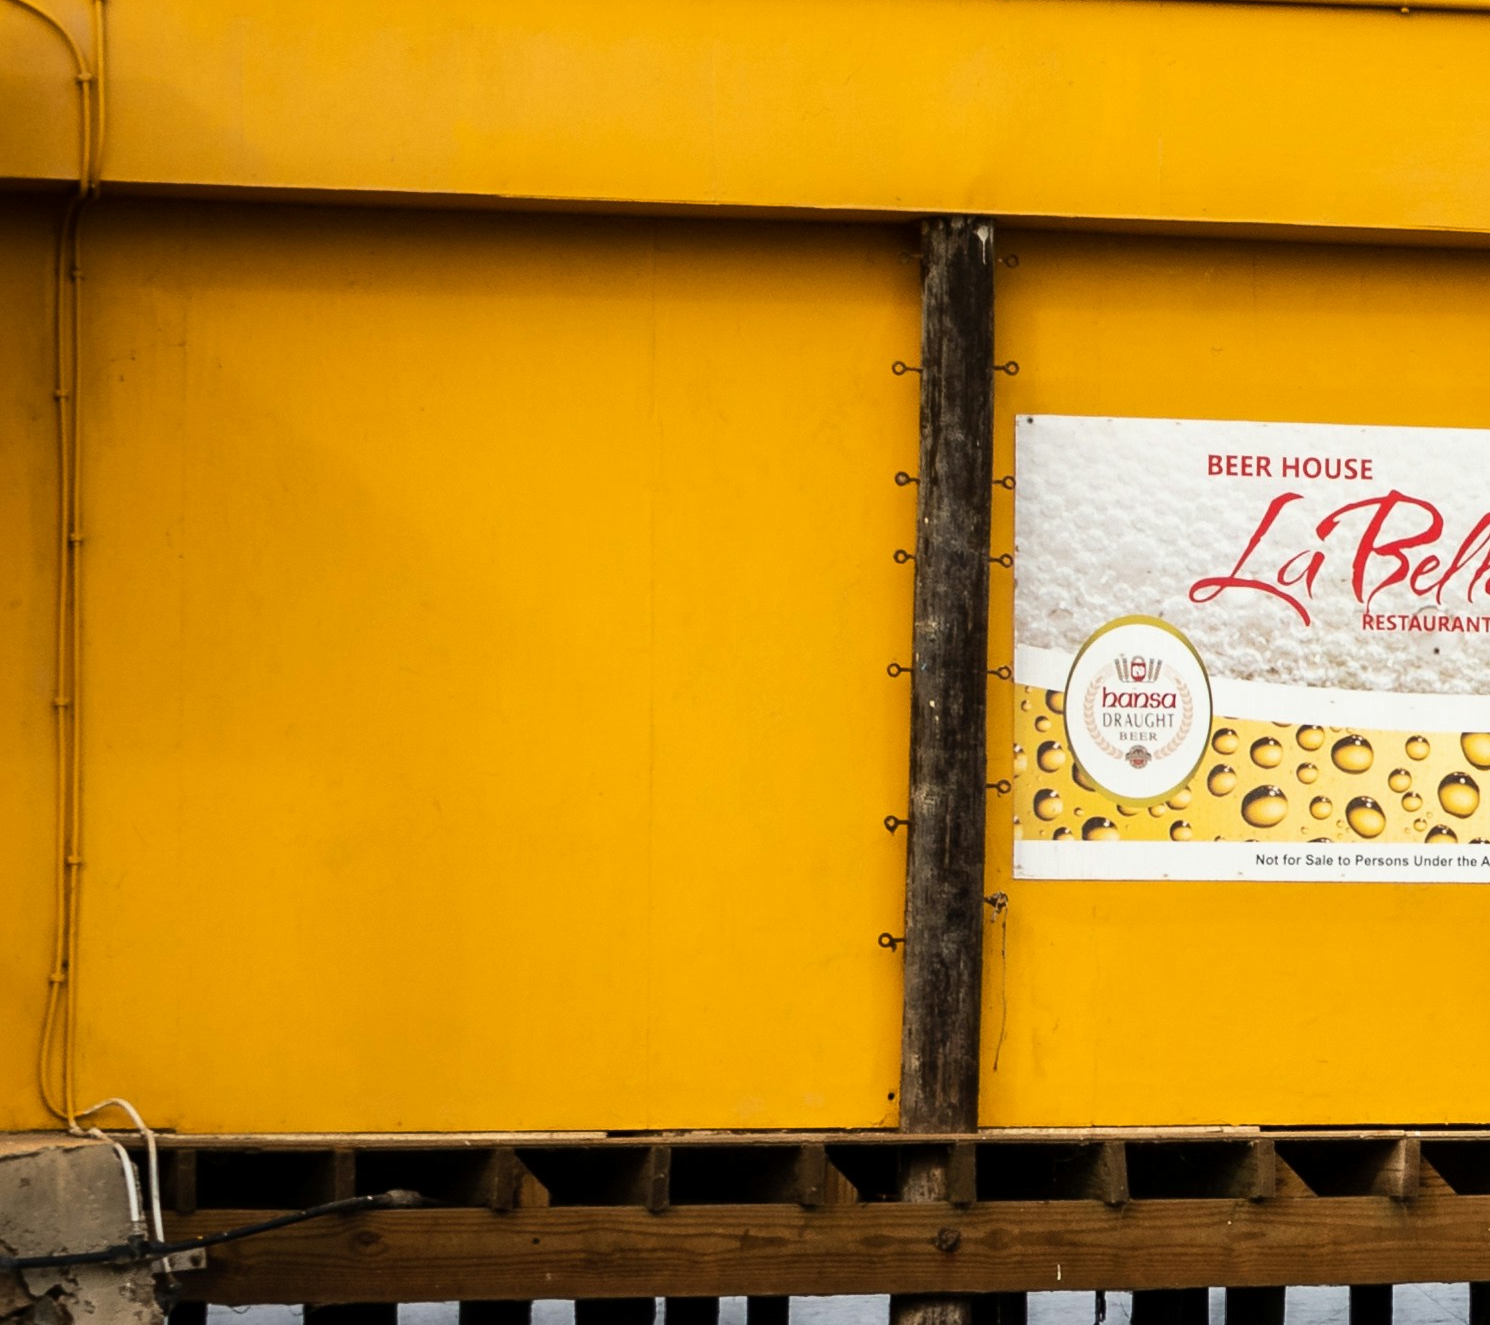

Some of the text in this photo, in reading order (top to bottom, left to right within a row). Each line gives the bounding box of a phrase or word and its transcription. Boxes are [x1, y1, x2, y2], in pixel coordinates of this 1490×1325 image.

[1207, 454, 1373, 480] BEER HOUSE
[1188, 491, 1326, 627] La
[1102, 686, 1177, 709] hansa
[1102, 712, 1175, 728] DRAUGHT
[1119, 731, 1158, 742] BEER
[1255, 854, 1279, 866] Not
[1283, 854, 1302, 865] for
[1305, 854, 1334, 866] Sale
[1338, 855, 1351, 866] to
[1355, 854, 1409, 866] Persons
[1414, 855, 1453, 867] Under
[1457, 855, 1477, 867] the
